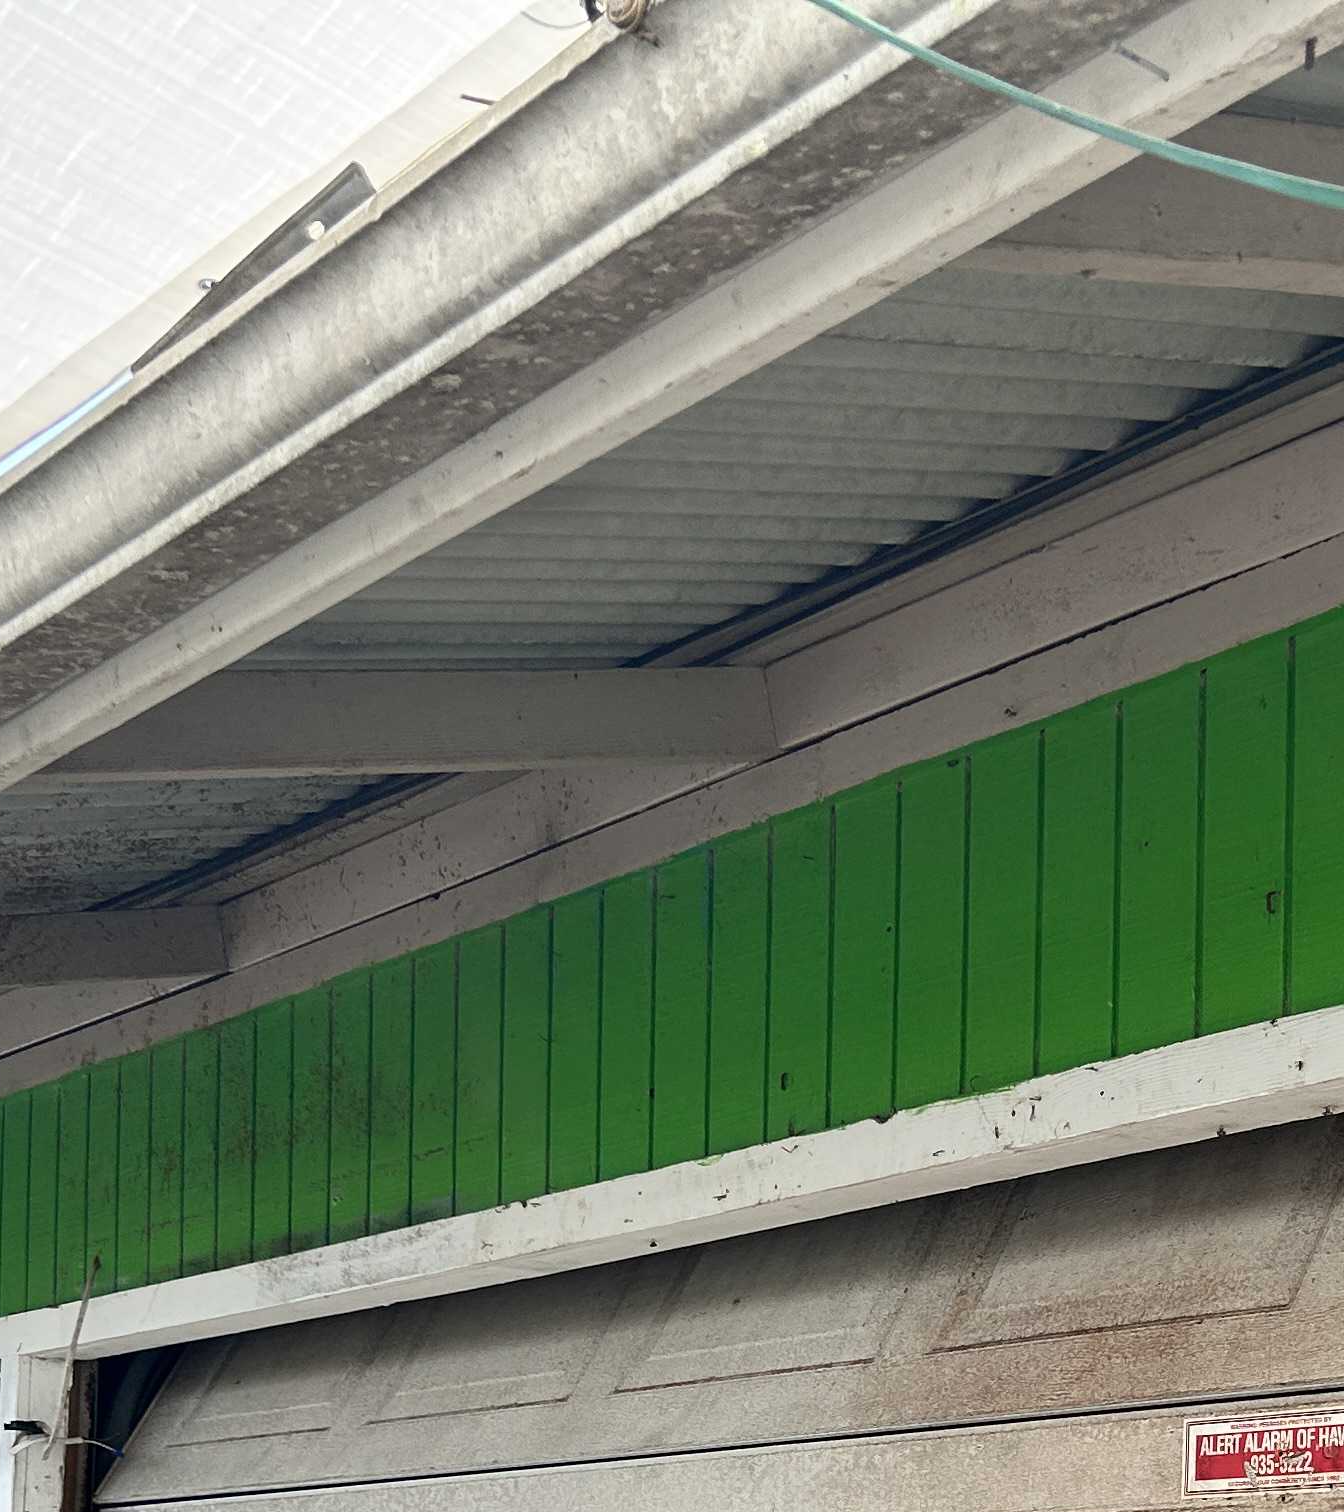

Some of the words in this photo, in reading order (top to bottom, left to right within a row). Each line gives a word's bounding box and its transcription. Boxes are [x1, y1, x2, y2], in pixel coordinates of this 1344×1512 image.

[1200, 1433, 1242, 1457] ALERT
[1244, 1429, 1294, 1453] ALARM
[1297, 1427, 1316, 1449] OF
